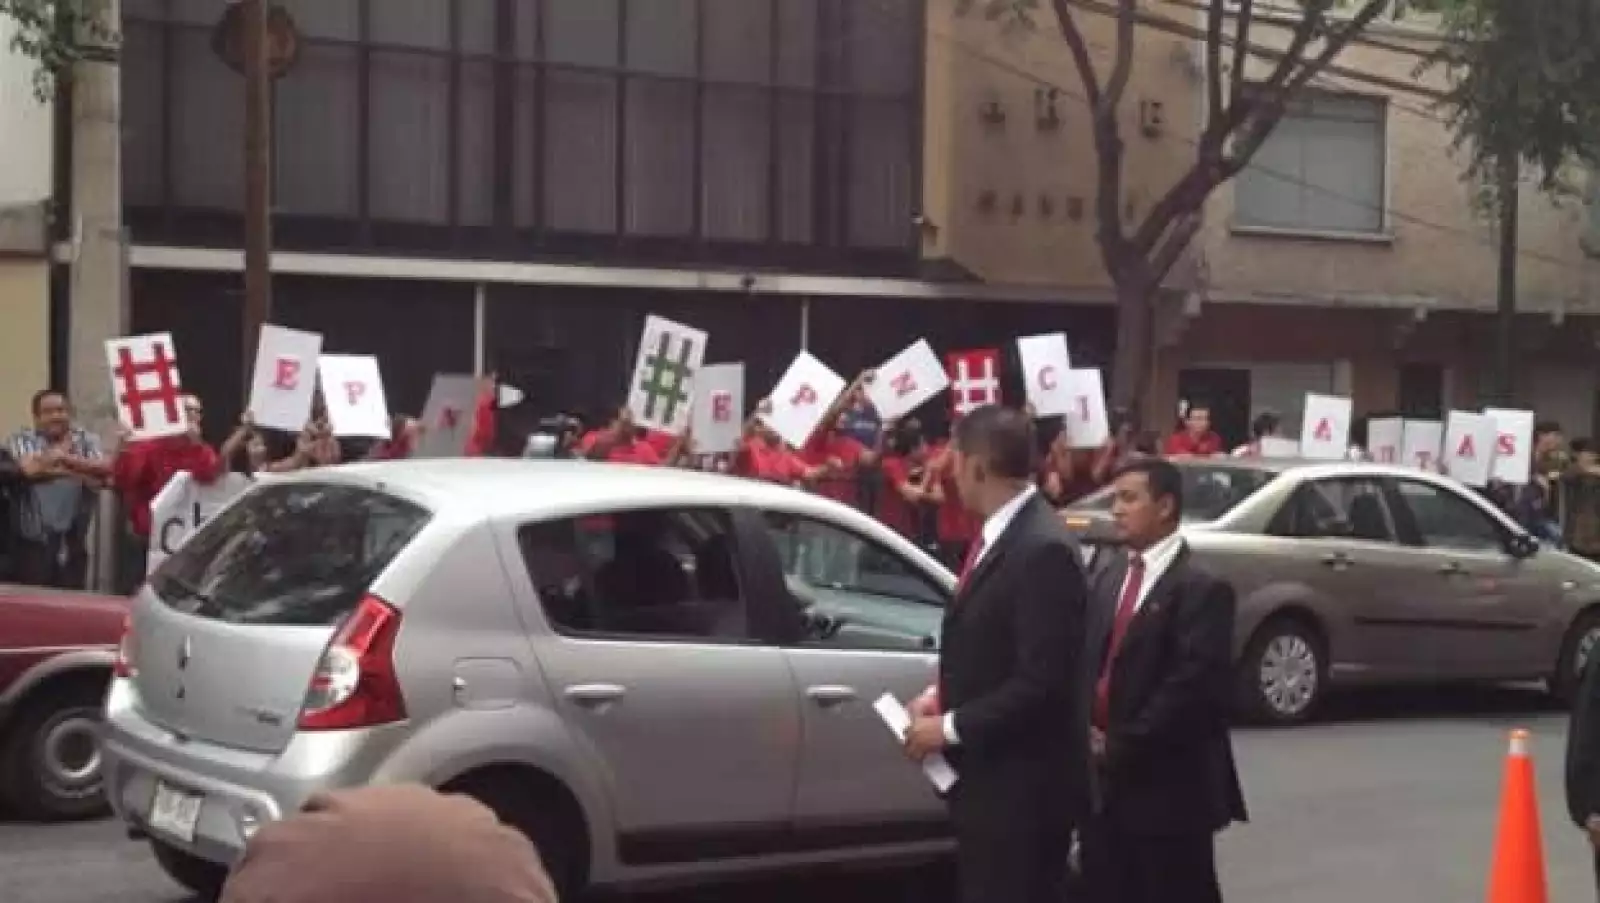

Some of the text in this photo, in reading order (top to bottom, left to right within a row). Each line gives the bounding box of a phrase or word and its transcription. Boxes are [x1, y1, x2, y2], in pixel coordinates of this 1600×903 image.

[273, 358, 299, 389] E
[1035, 364, 1056, 391] C
[343, 380, 366, 406] P
[711, 393, 733, 423] E
[1313, 418, 1332, 441] A
[1457, 434, 1476, 457] A
[1497, 434, 1516, 457] S
